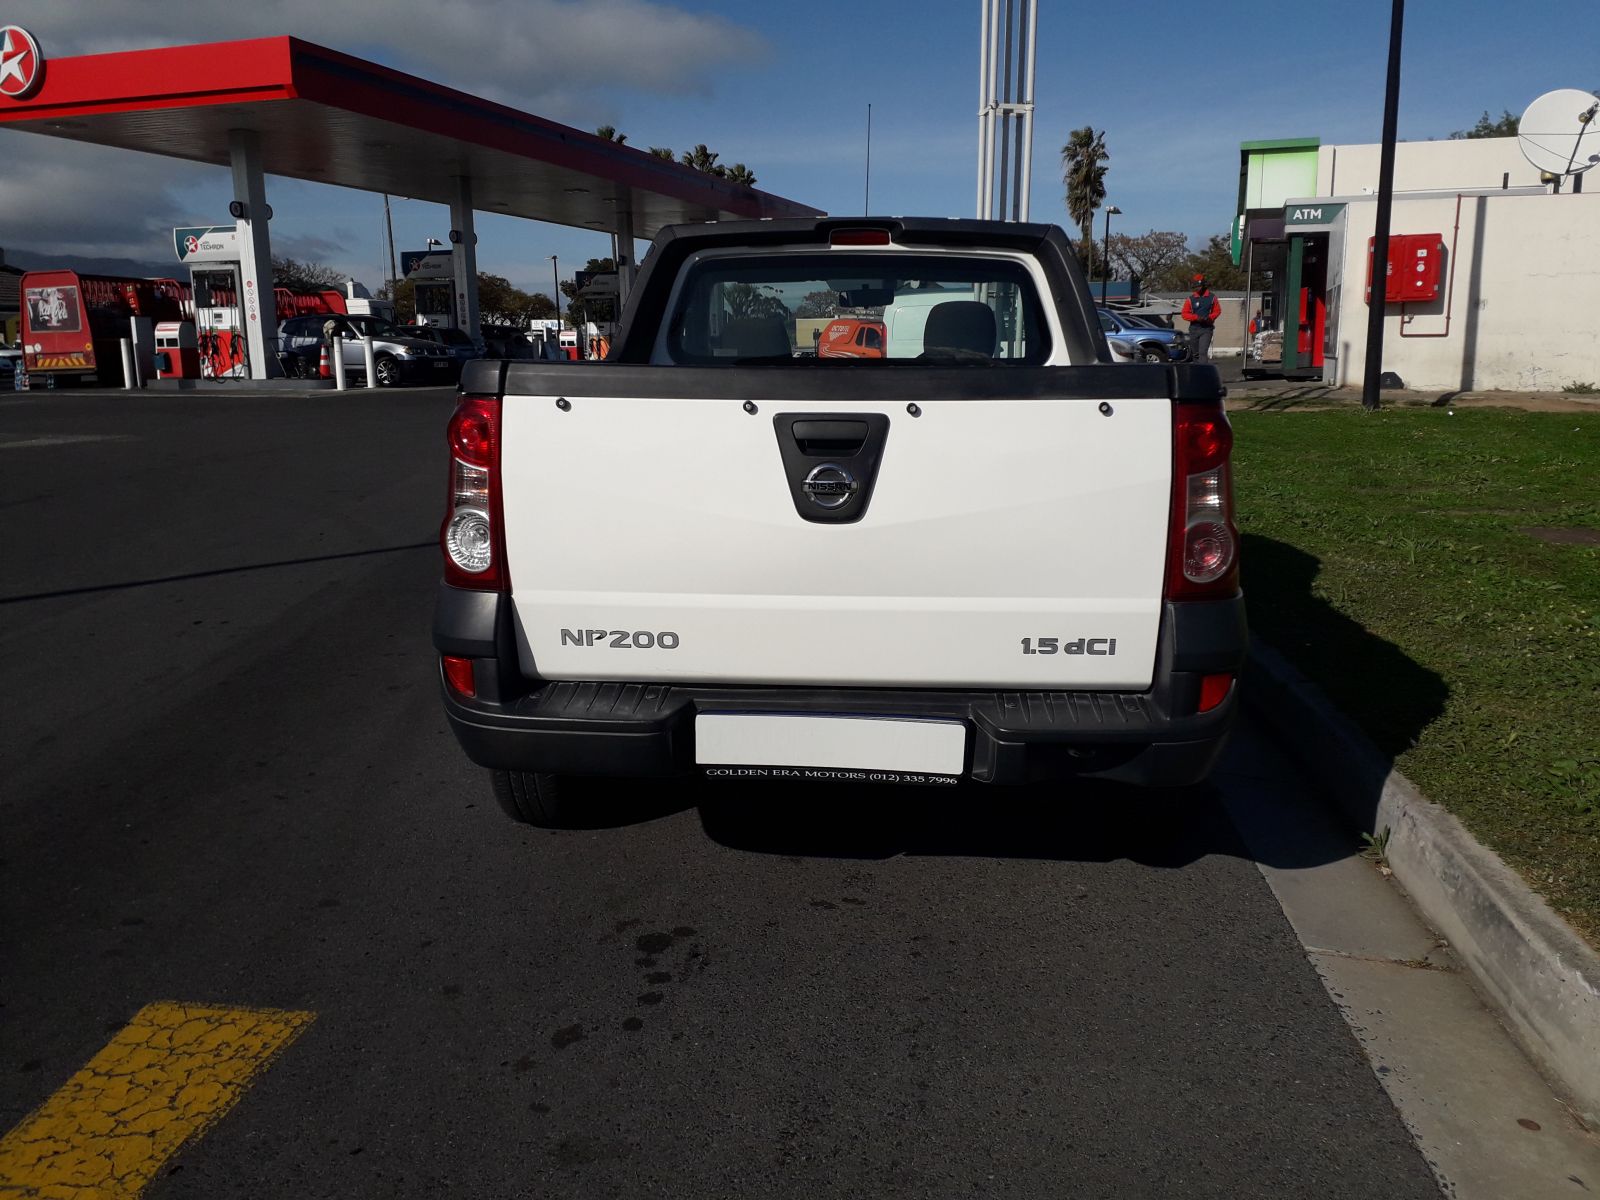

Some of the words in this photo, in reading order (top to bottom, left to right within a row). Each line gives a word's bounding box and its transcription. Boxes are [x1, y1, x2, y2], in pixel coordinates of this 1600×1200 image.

[1293, 208, 1322, 220] ATM
[808, 482, 852, 491] NISSAN
[560, 628, 680, 649] NP200
[1021, 637, 1059, 655] 1.5
[706, 768, 769, 777] GOLDEN
[772, 769, 801, 777] ERA
[804, 770, 867, 780] MOTORS
[869, 773, 900, 783] (012)
[903, 774, 925, 783] 335
[928, 776, 958, 785] 7996
